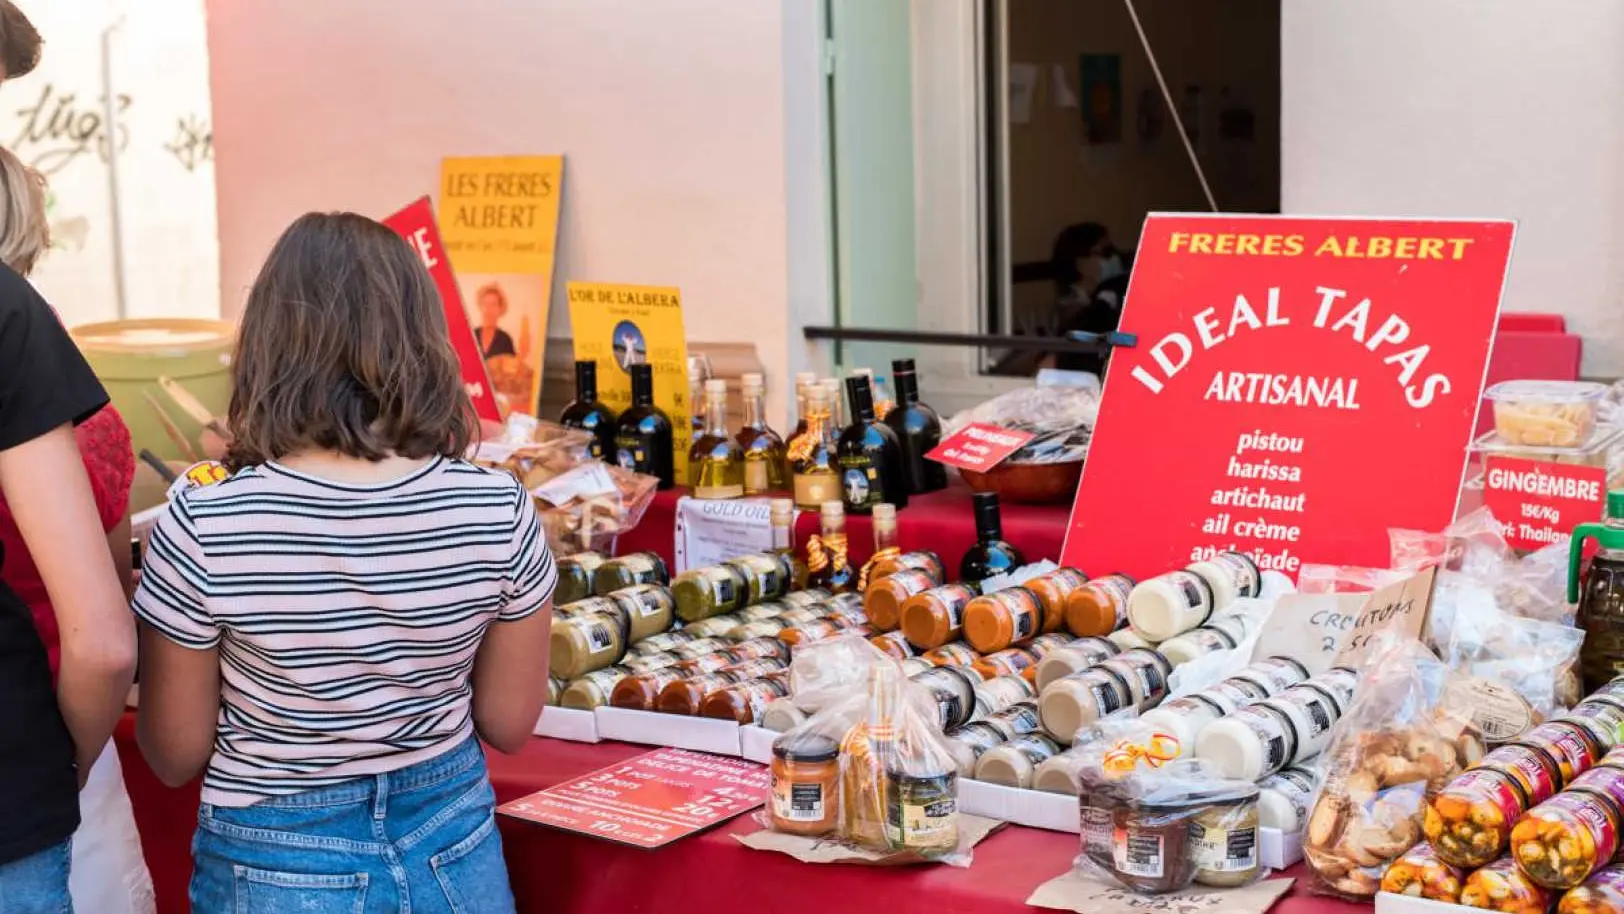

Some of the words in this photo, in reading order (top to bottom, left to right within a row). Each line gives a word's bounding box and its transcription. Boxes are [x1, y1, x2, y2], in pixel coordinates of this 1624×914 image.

[447, 172, 479, 198] LES
[483, 171, 552, 198] FRERES
[453, 204, 538, 229] ALBERT
[1168, 232, 1304, 257] FRERES
[1315, 235, 1475, 260] ALBERT
[568, 289, 595, 303] L'OR
[598, 290, 615, 305] DE
[617, 292, 680, 308] L'ALBERA
[1131, 286, 1291, 395] IDEAL
[1313, 285, 1452, 409] TAPAS
[1204, 371, 1360, 410] ARTISANAL
[1236, 429, 1304, 454] pistou
[1227, 456, 1301, 482] harissa
[1489, 468, 1600, 501] GINGEMBRE
[703, 502, 743, 517] GOLD
[745, 506, 770, 520] OIL
[1211, 486, 1305, 512] artichaut
[1202, 513, 1230, 535] ail
[1233, 516, 1301, 541] crème
[1519, 523, 1574, 544] Thailan
